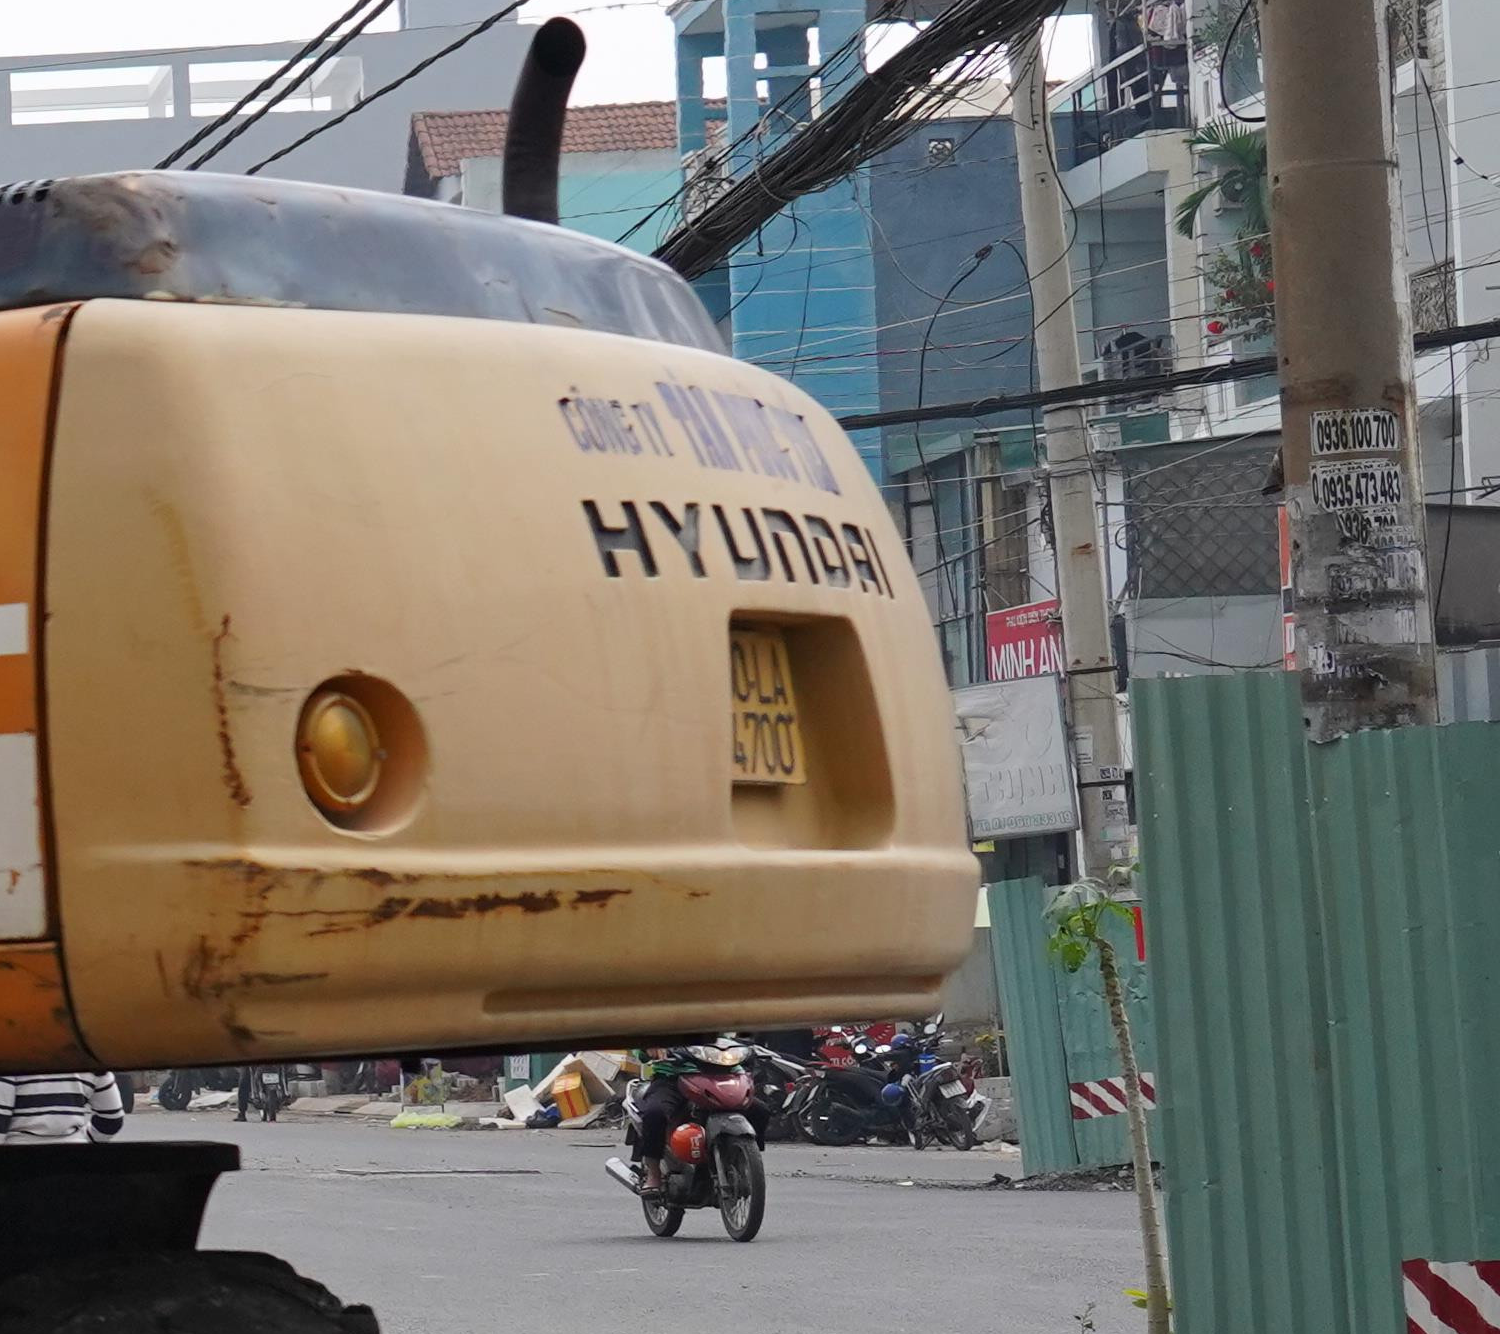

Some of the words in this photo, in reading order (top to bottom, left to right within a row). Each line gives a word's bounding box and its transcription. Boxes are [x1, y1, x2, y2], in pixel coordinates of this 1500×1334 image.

[1317, 414, 1395, 452] 0936.100.700
[1322, 470, 1401, 508] 0935.473.483
[581, 499, 894, 600] HYUNDAI
[991, 638, 1036, 681] MINH
[1039, 633, 1064, 675] AN
